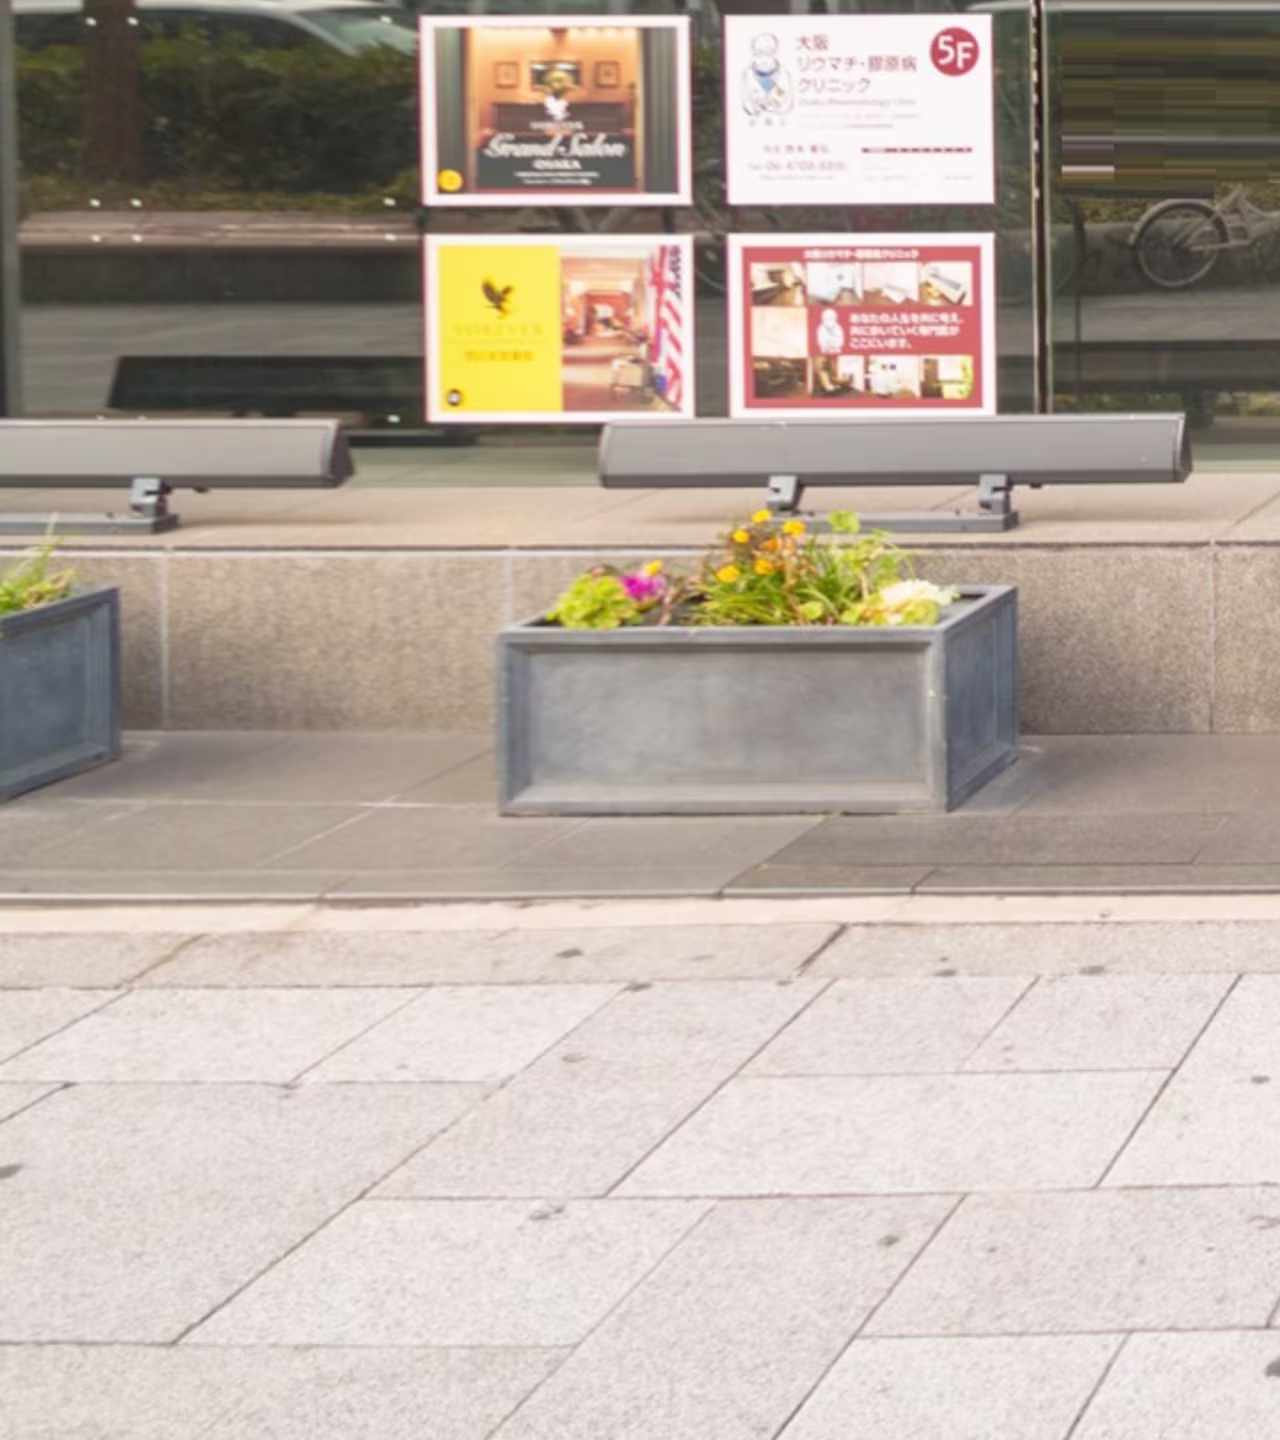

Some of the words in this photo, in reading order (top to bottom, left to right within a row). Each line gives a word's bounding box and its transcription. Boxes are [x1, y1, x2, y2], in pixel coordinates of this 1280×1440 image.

[796, 34, 829, 51] 大阪
[937, 35, 975, 70] 5F
[798, 77, 872, 94] クリニック
